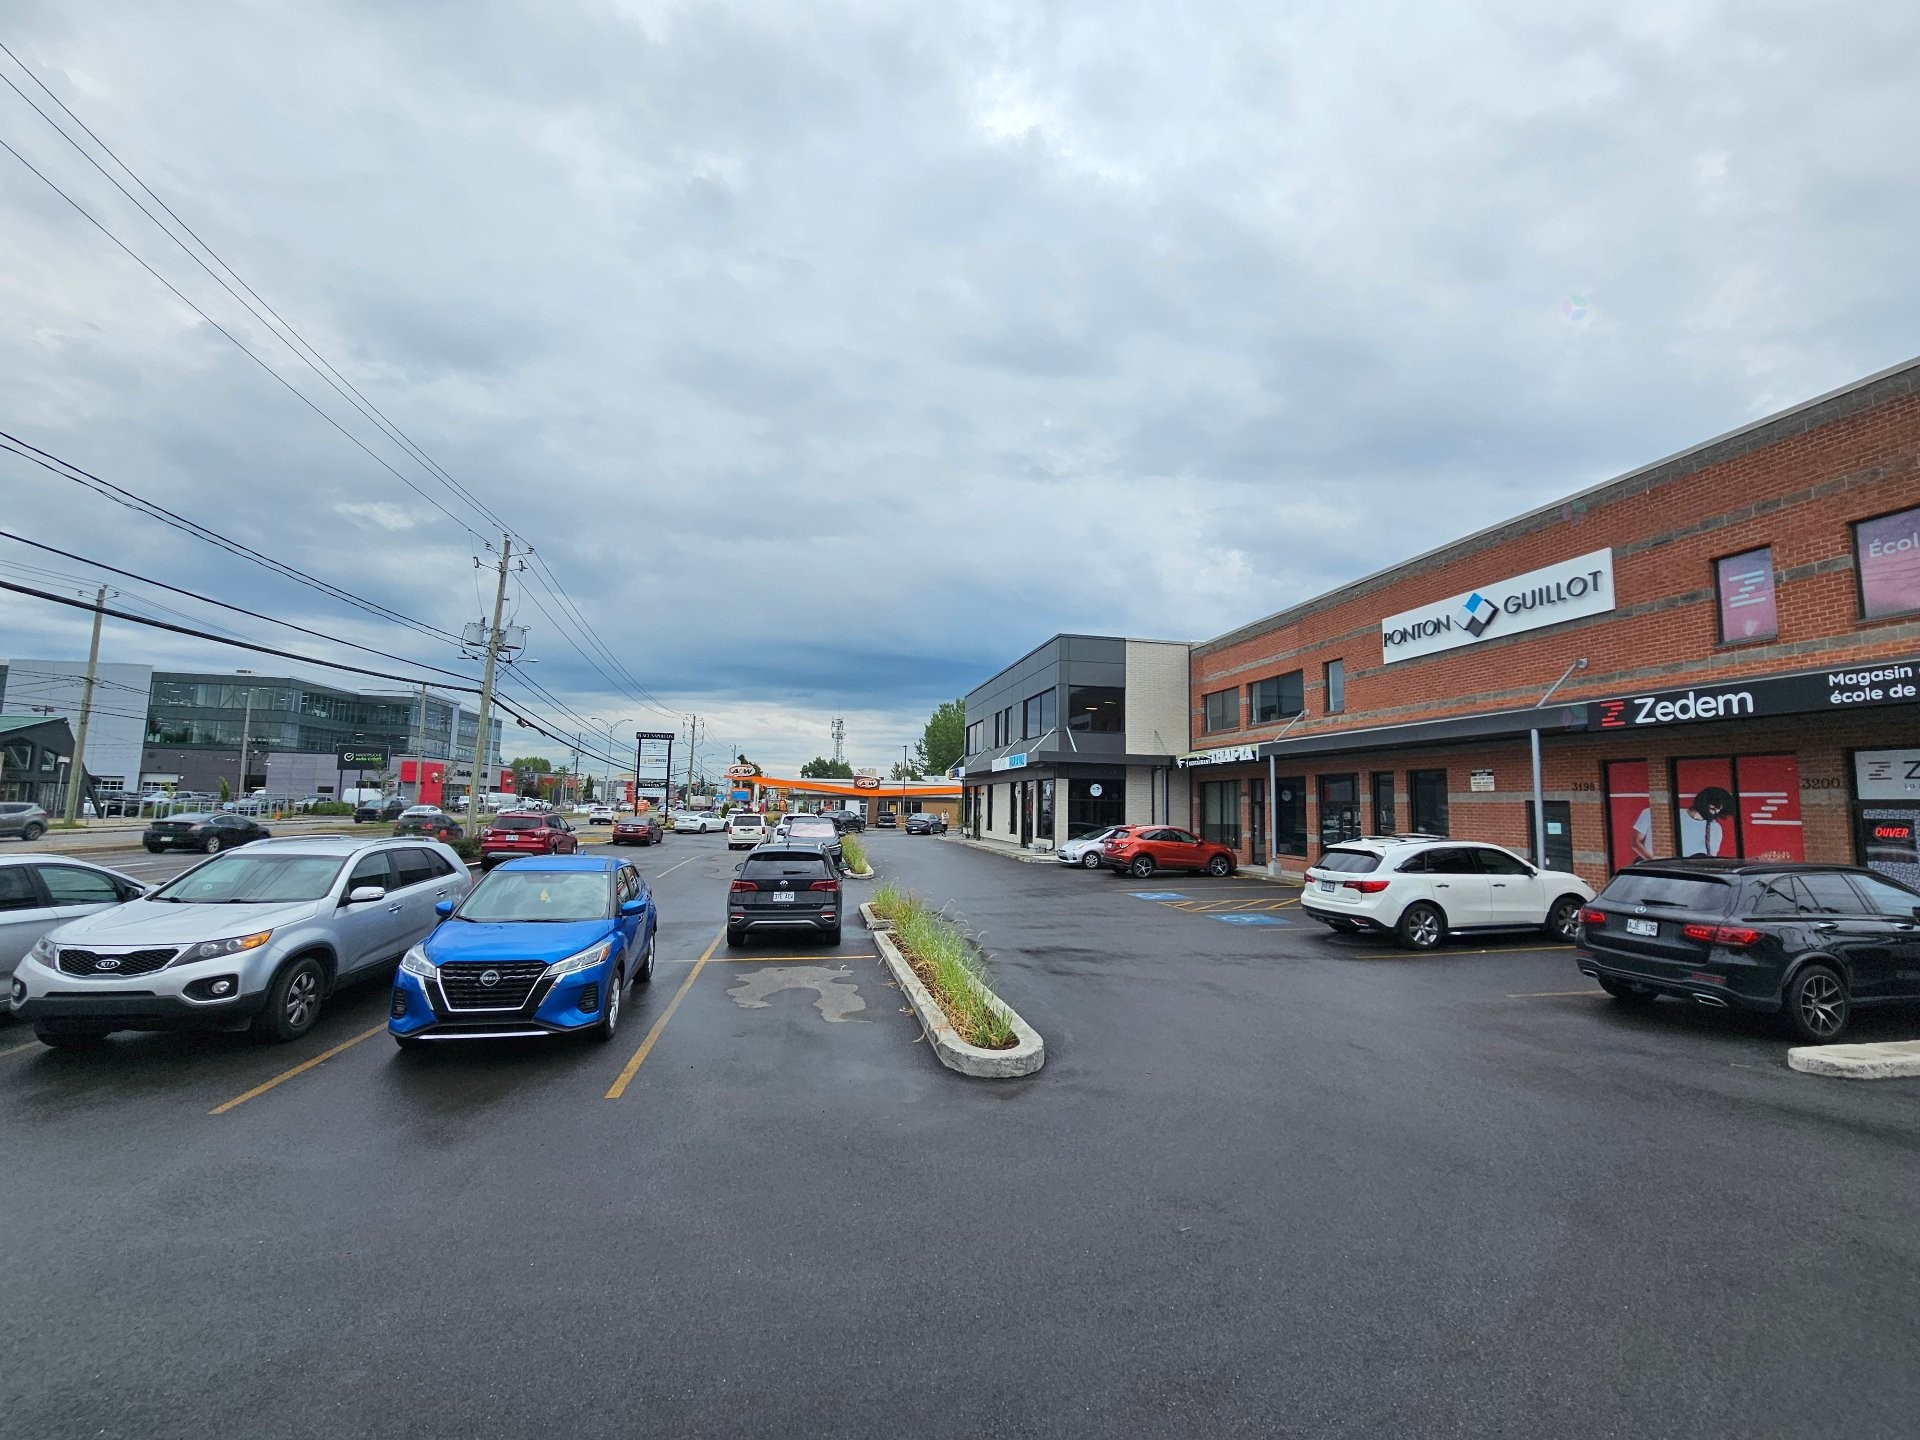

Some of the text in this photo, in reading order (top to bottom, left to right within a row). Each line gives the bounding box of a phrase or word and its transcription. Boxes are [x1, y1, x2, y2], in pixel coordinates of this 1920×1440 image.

[1384, 571, 1602, 648] PONTON GUILLOT
[1829, 666, 1912, 686] Magasin
[1830, 684, 1916, 704] école de
[1634, 691, 1753, 724] Zedem
[1571, 782, 1596, 792] 3198
[1802, 777, 1840, 789] 3200
